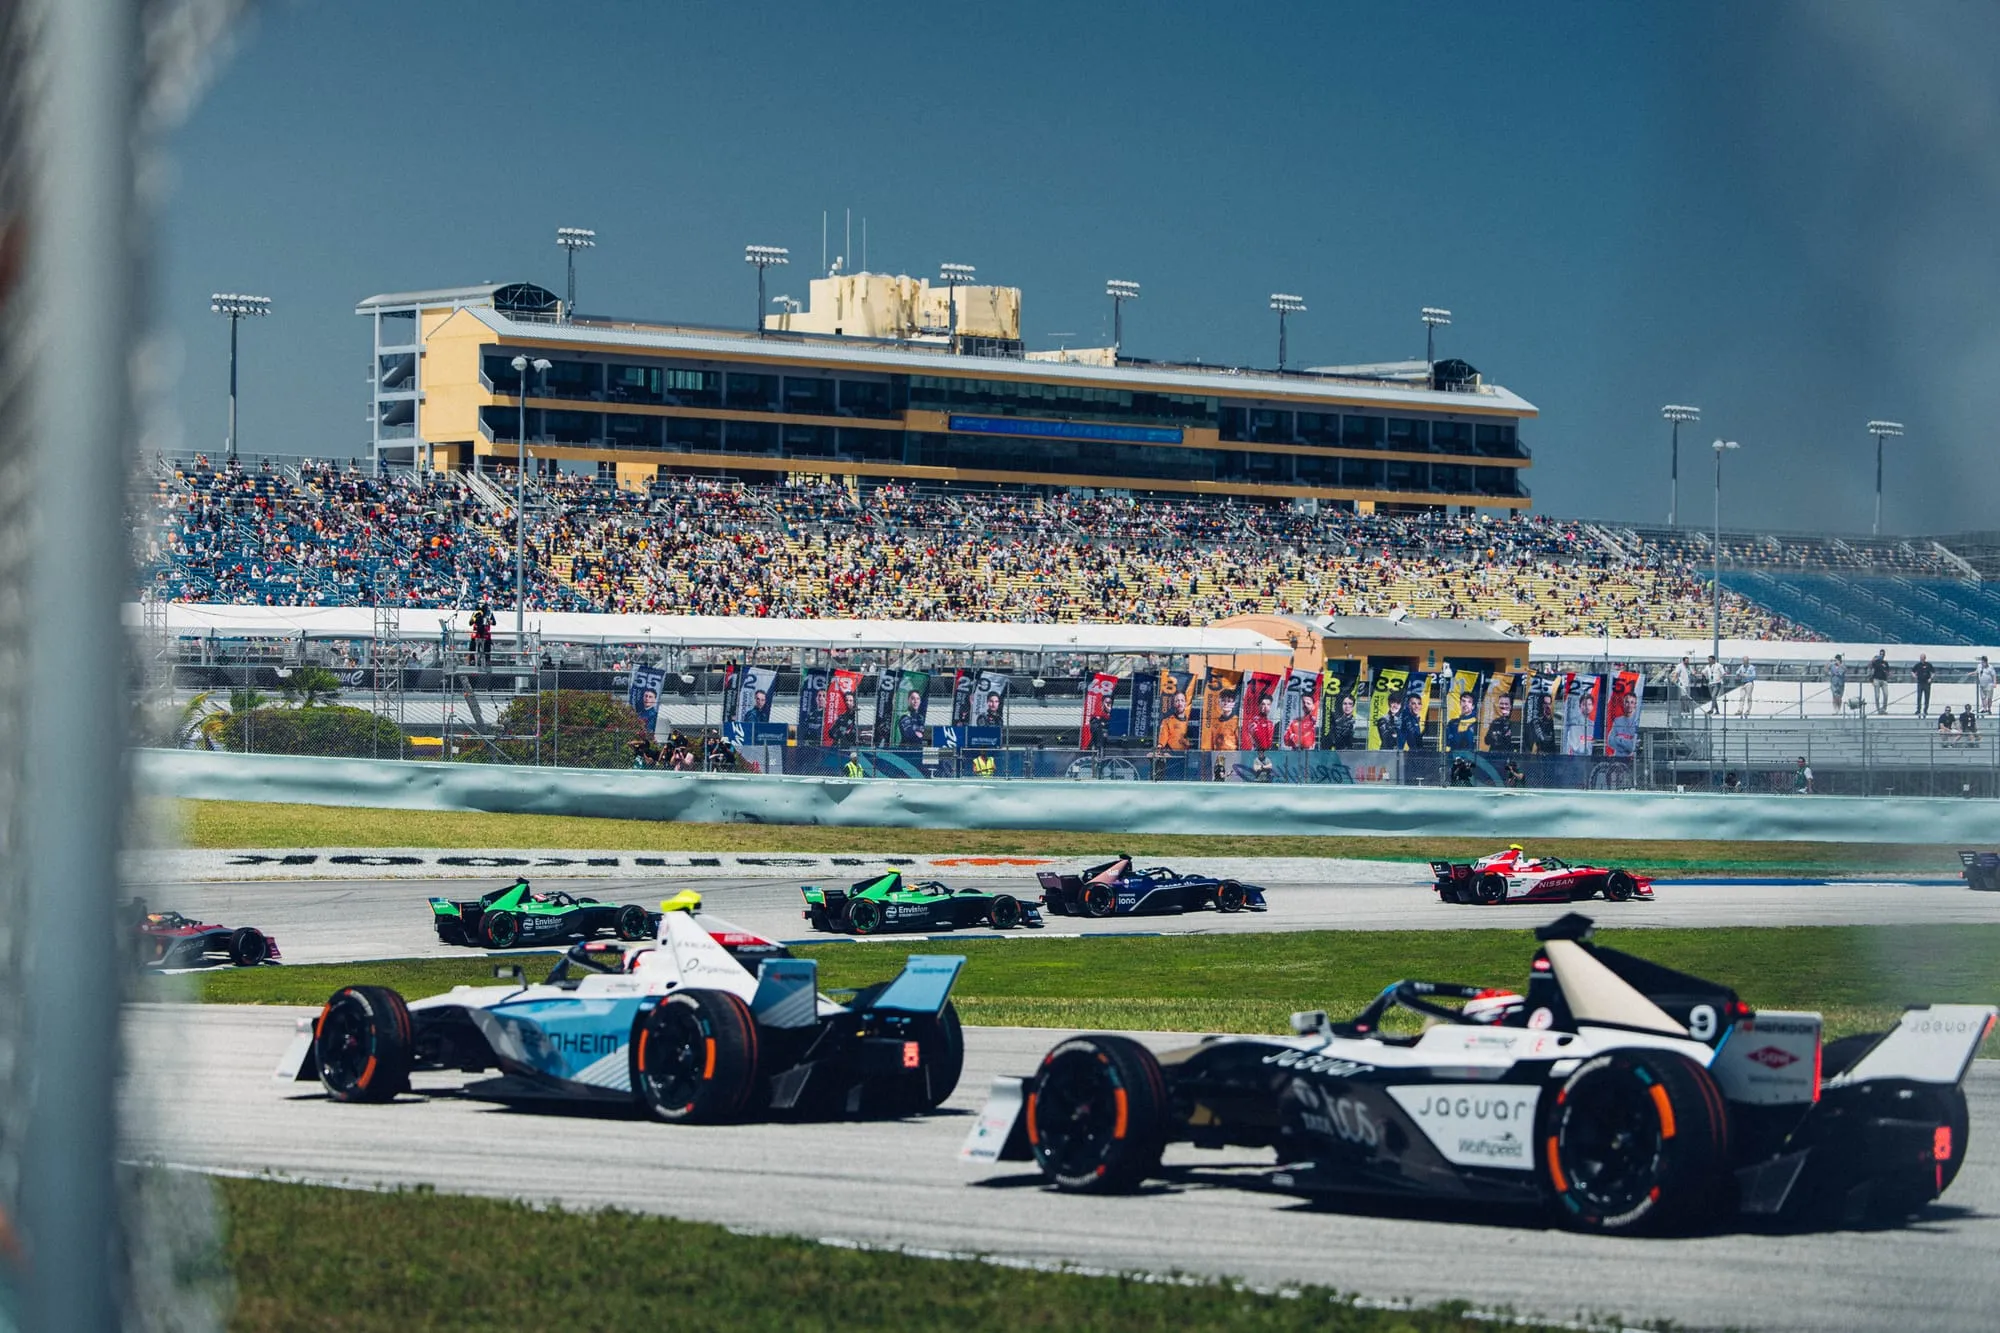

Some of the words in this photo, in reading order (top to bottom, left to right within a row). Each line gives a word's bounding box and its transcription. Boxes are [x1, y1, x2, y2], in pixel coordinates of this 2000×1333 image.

[634, 672, 661, 688] 55
[744, 674, 757, 689] 2
[806, 674, 826, 690] 16
[1088, 679, 1113, 695] 48
[1247, 678, 1271, 692] 17
[1288, 676, 1316, 692] 23
[1375, 676, 1404, 692] 33
[1531, 676, 1552, 692] 25
[1569, 680, 1595, 695] 27
[1613, 678, 1637, 693] 51
[1538, 878, 1575, 889] NISSAN
[898, 906, 928, 914] Envision
[534, 917, 562, 927] Envision
[1689, 1004, 1716, 1041] 9
